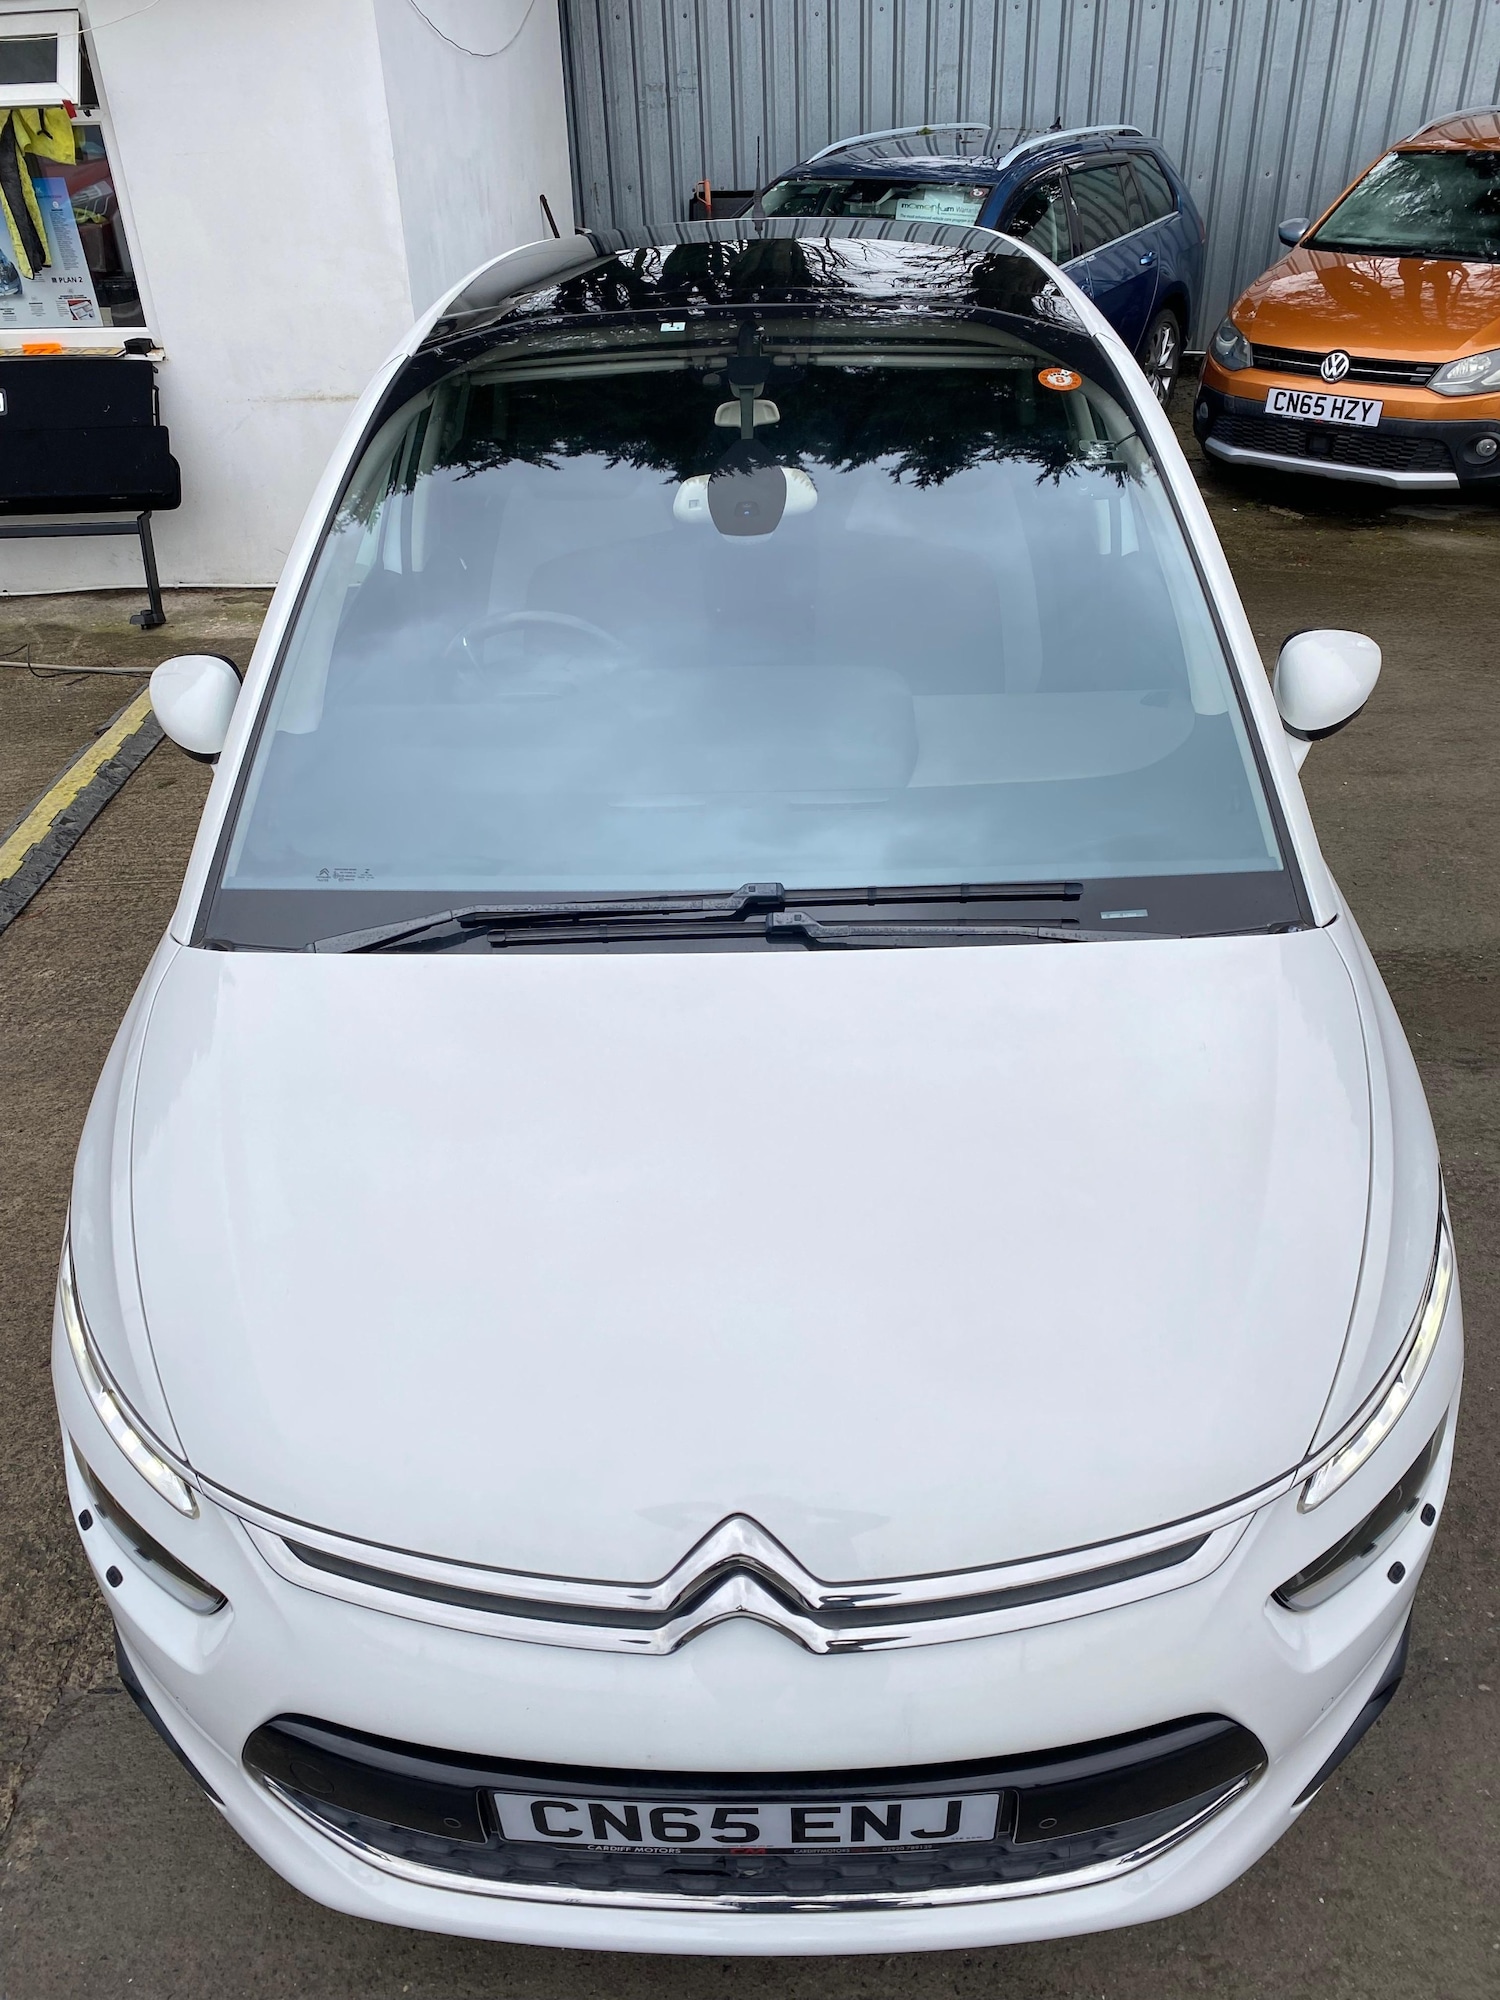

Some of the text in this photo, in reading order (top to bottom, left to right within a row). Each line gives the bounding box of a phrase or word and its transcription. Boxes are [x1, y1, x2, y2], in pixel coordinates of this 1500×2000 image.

[1273, 391, 1374, 422] CN65 HZY
[530, 1800, 962, 1842] CN65 ENJ
[587, 1844, 681, 1855] CARDIFF MOTORS
